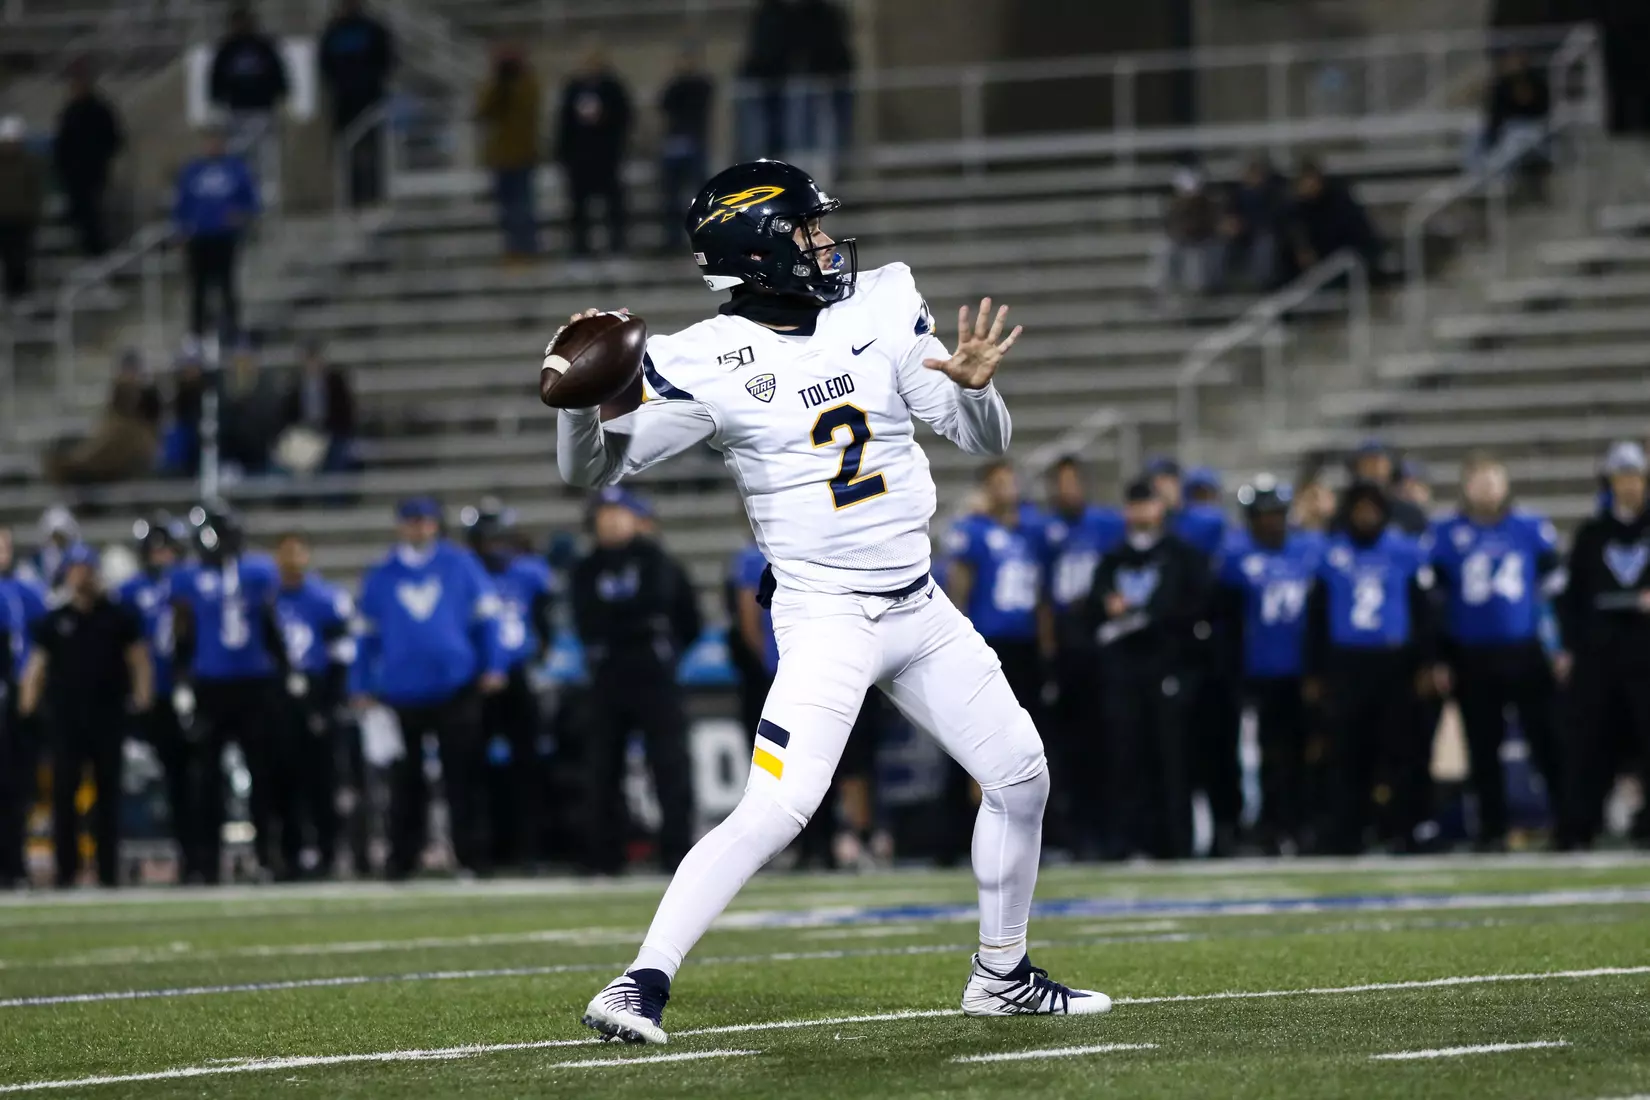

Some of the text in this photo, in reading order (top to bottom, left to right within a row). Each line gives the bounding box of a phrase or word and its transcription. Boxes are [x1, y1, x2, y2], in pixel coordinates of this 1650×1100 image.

[717, 347, 755, 371] 150
[749, 379, 776, 395] MAC
[798, 374, 855, 409] TOLEDO
[811, 402, 888, 511] 2
